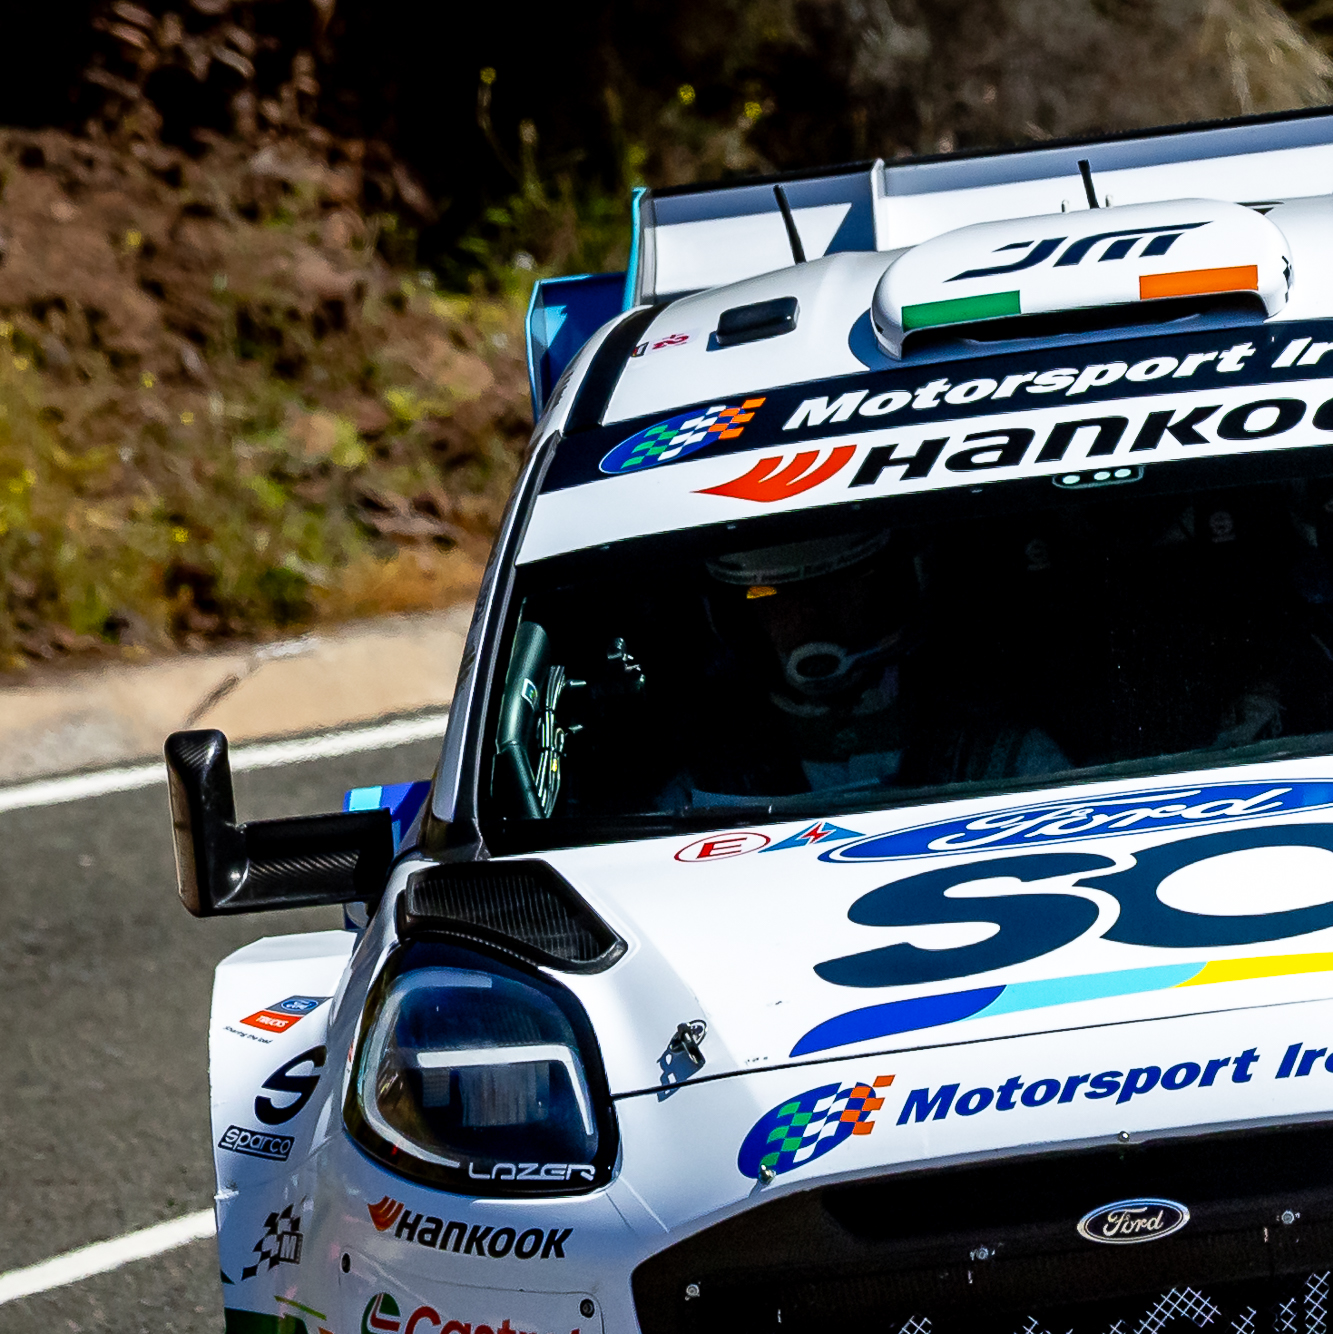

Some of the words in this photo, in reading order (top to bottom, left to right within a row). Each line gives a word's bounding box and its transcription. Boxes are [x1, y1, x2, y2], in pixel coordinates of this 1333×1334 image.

[782, 343, 1256, 432] Motorsport
[928, 786, 1292, 851] Ford
[895, 1047, 1261, 1125] Motorsport
[225, 1127, 292, 1153] sparco
[468, 1162, 596, 1182] LAZER
[1103, 1206, 1164, 1235] Ford
